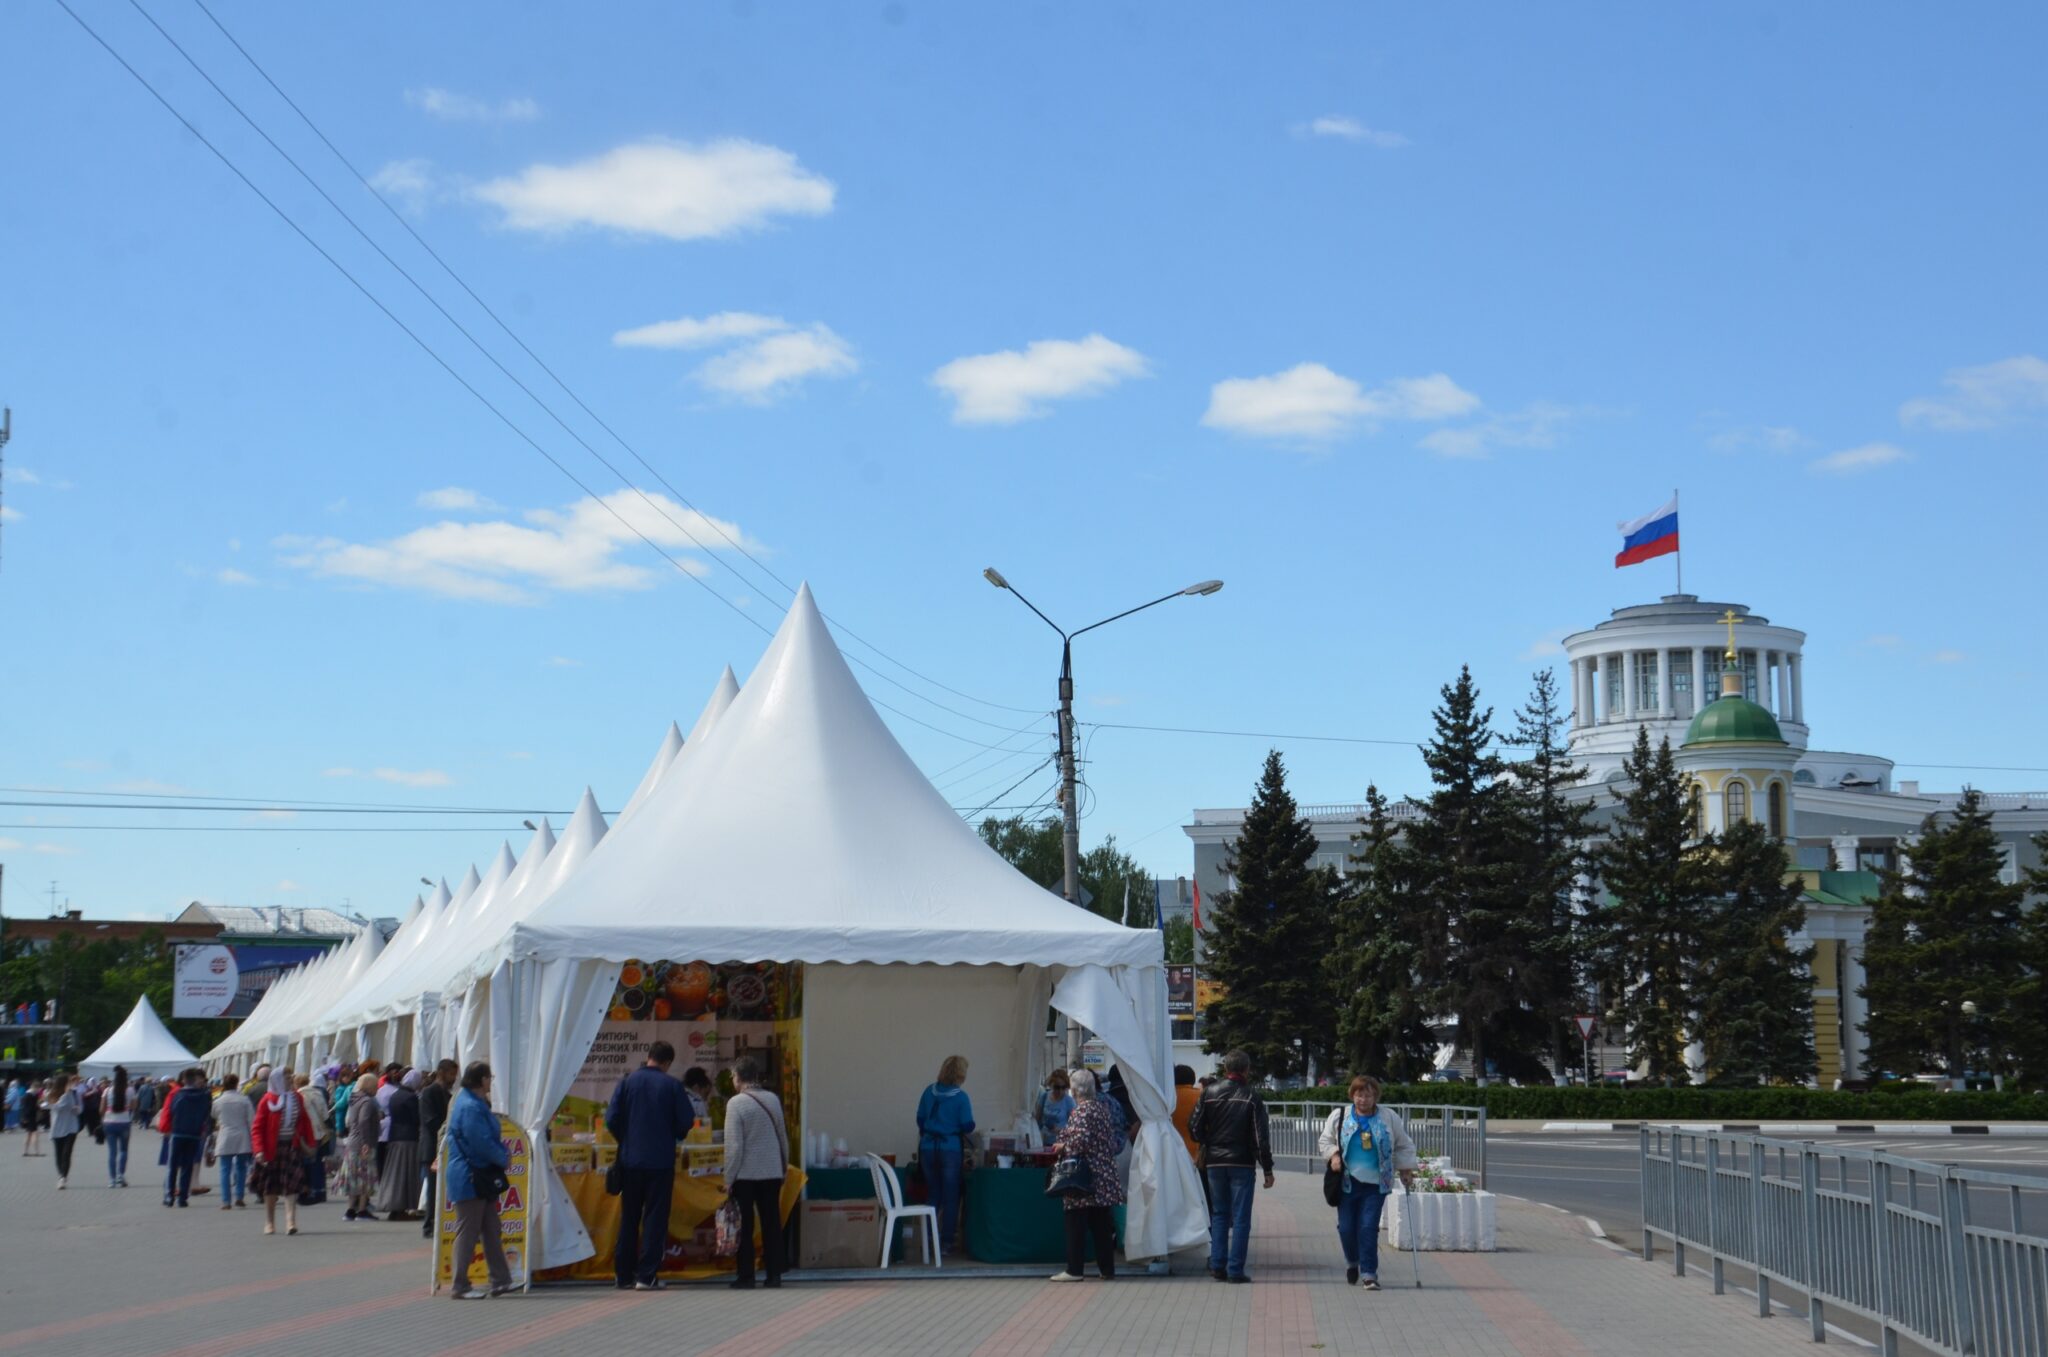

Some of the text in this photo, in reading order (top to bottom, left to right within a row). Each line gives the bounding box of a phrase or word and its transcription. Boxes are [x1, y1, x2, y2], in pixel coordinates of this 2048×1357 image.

[595, 1032, 638, 1041] ФИТЮРЫ
[591, 1042, 650, 1052] СВЕЖИХ ЯГО
